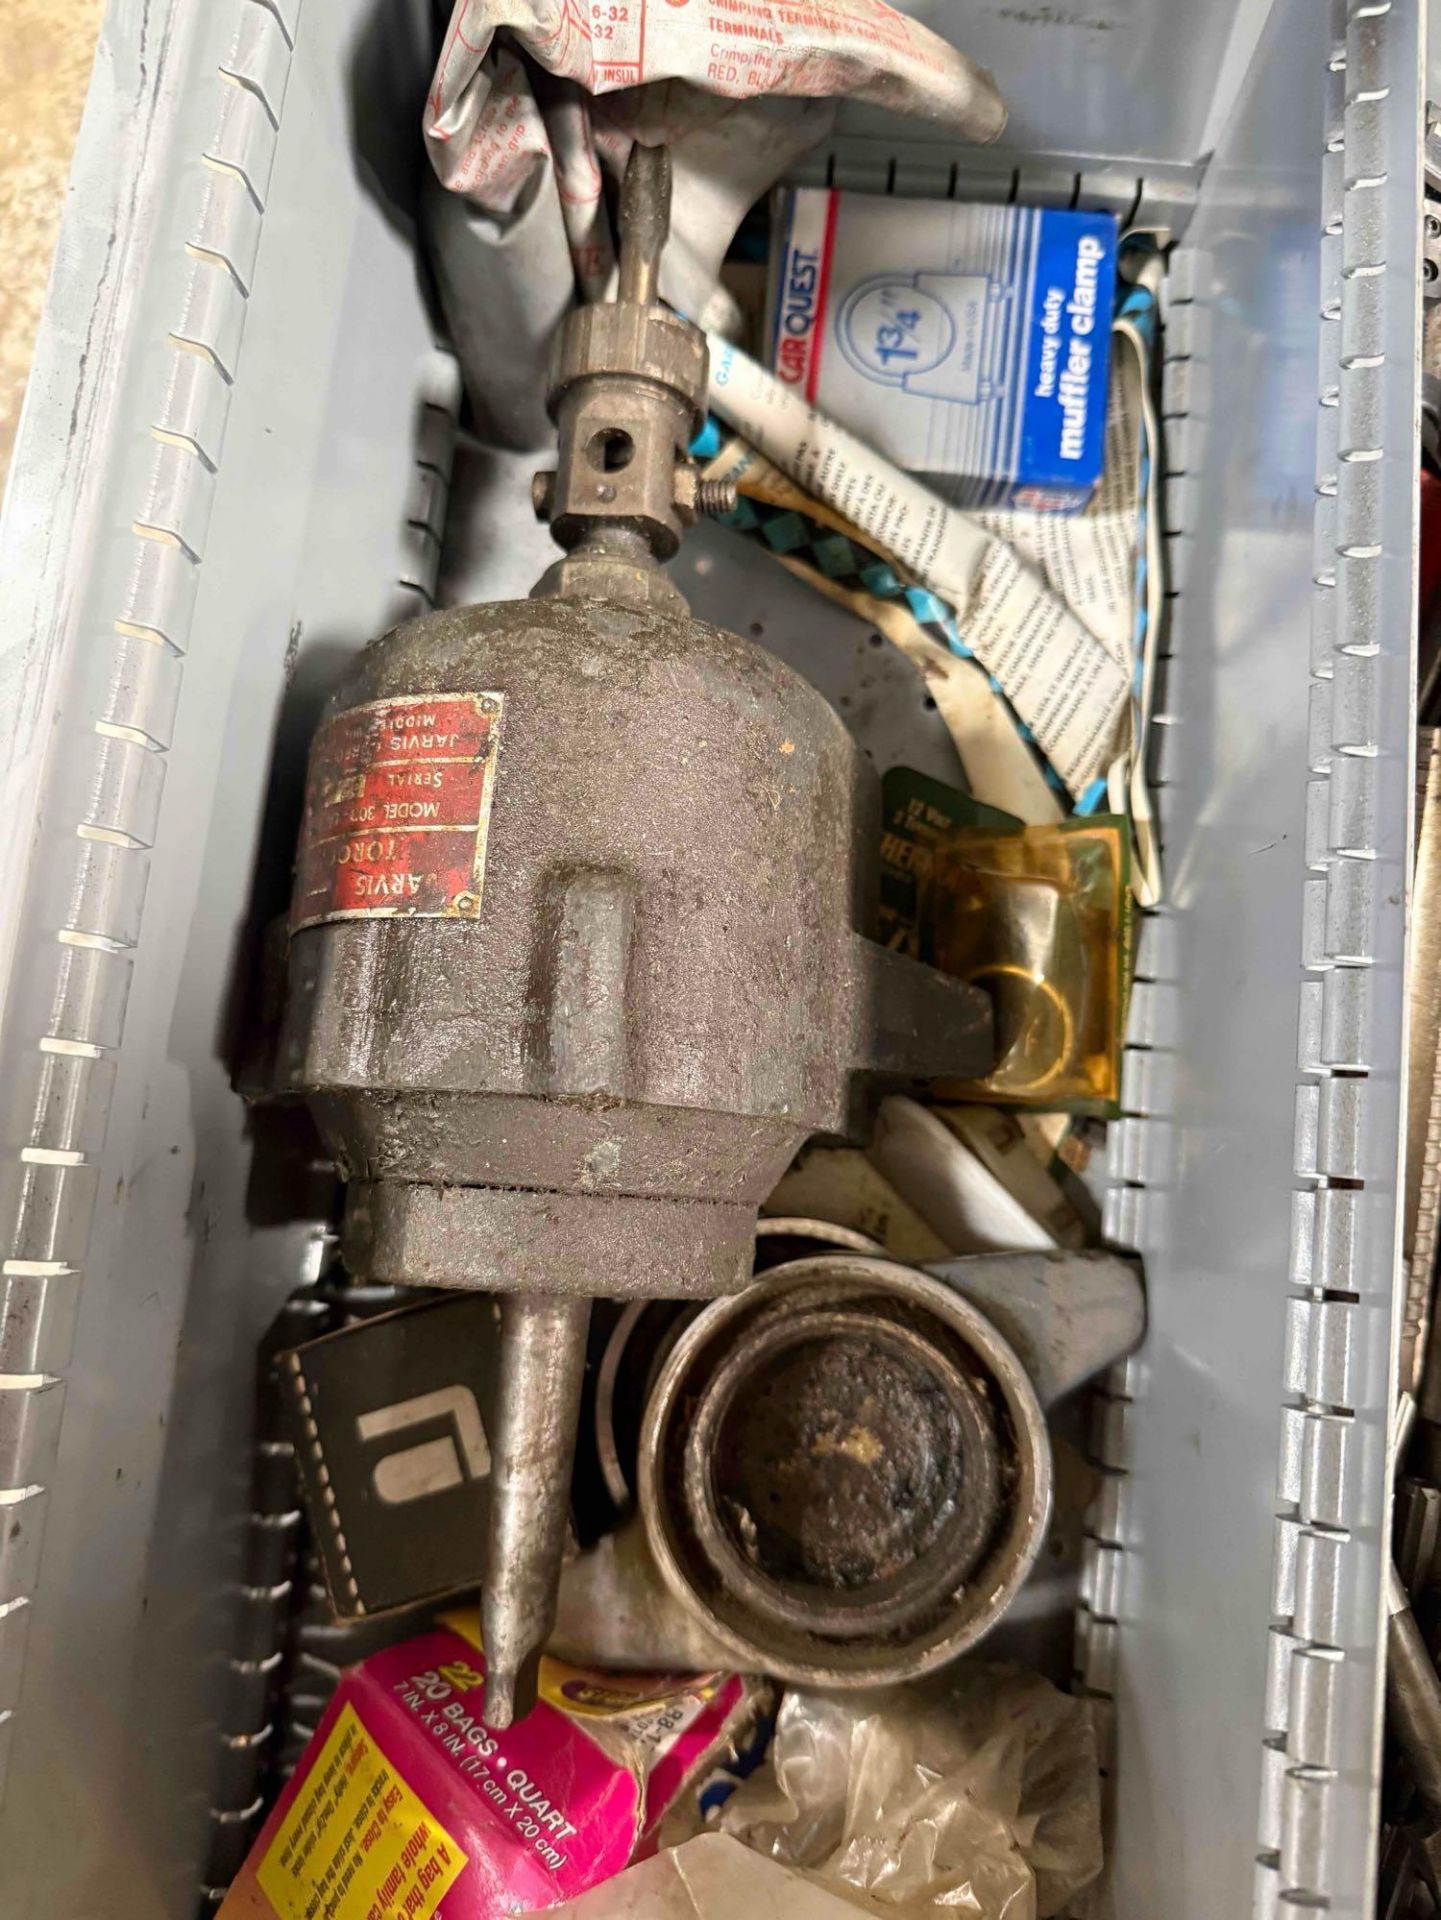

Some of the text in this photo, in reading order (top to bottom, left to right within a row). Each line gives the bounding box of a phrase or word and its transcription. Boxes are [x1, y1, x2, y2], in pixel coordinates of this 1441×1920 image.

[708, 16, 783, 44] TERMINALS
[710, 43, 772, 68] Crimp the
[603, 68, 635, 82] INSUL
[707, 63, 740, 84] RED,
[506, 122, 526, 151] grip
[1035, 288, 1066, 398] heavy duty
[1059, 235, 1105, 460] muffler clamp
[390, 733, 459, 751] JARVIS
[388, 771, 442, 790] SERIAL
[384, 801, 440, 822] MODEL
[409, 1670, 578, 1841] 20 BAGS QUART
[392, 1679, 567, 1871] 7 IN. X 8 IN. (17 cm X 20 cm)
[382, 1783, 403, 1812] Easy
[375, 1808, 389, 1825] to
[398, 1821, 431, 1869] whole
[435, 1842, 452, 1865] A
[376, 1862, 407, 1910] family
[416, 1855, 444, 1891] bag
[401, 1884, 425, 1919] that
